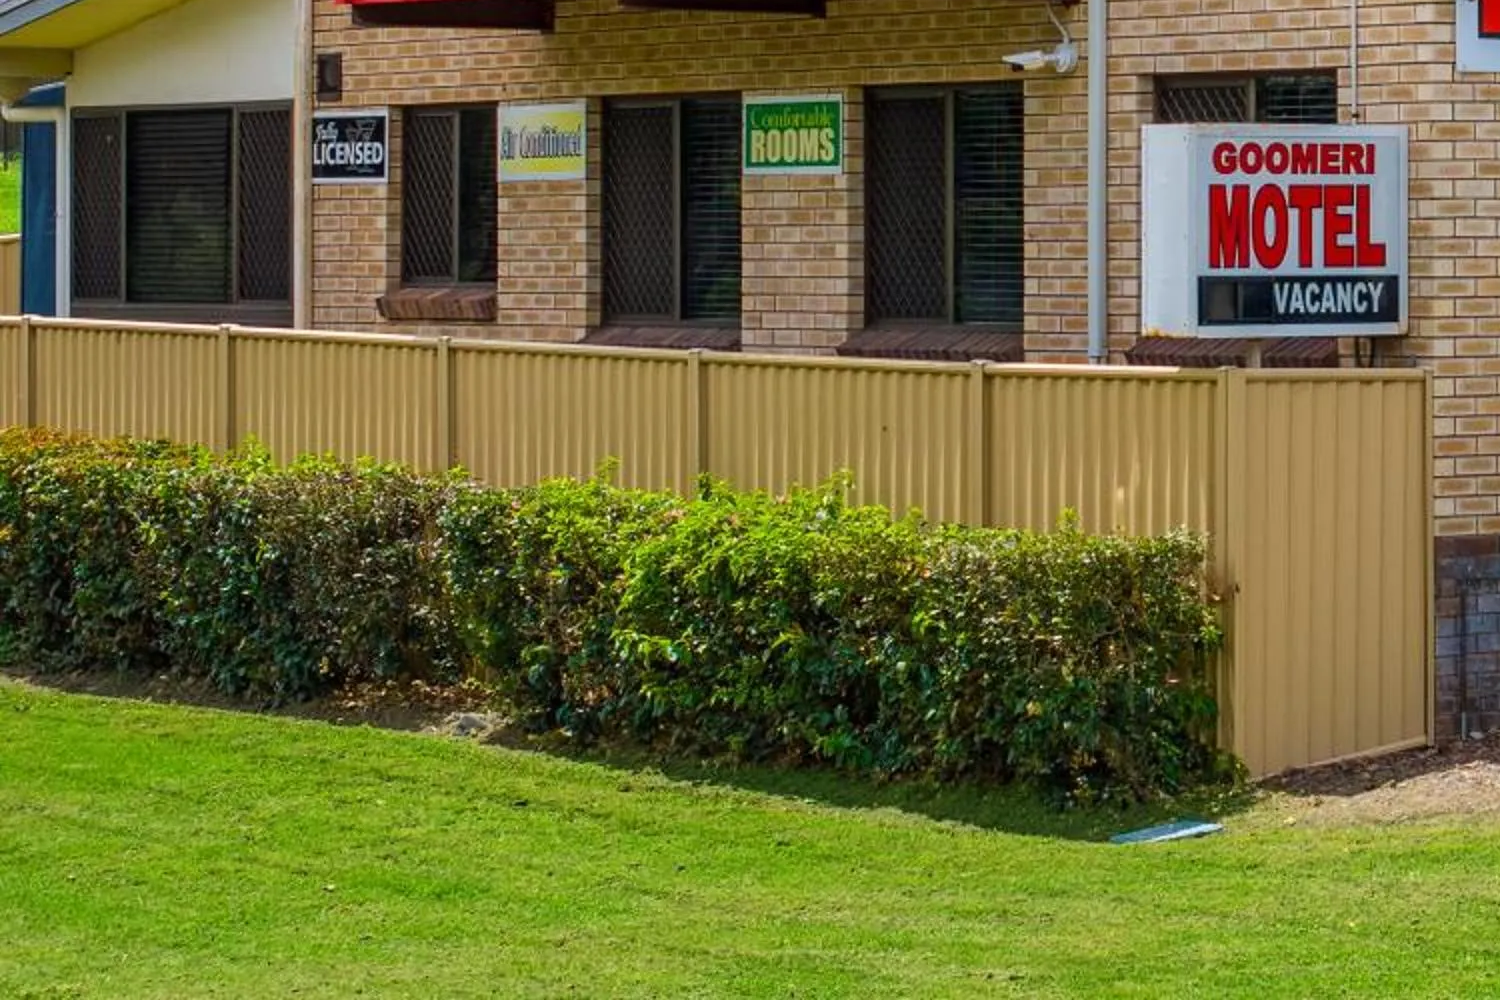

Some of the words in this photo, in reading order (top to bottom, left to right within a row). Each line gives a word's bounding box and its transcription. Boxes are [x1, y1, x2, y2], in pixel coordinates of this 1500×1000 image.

[313, 141, 383, 165] LICENSED
[751, 127, 835, 163] ROOMS
[1212, 142, 1376, 175] GOOMERI
[1208, 183, 1386, 270] MOTEL
[1273, 282, 1384, 314] VACANCY
